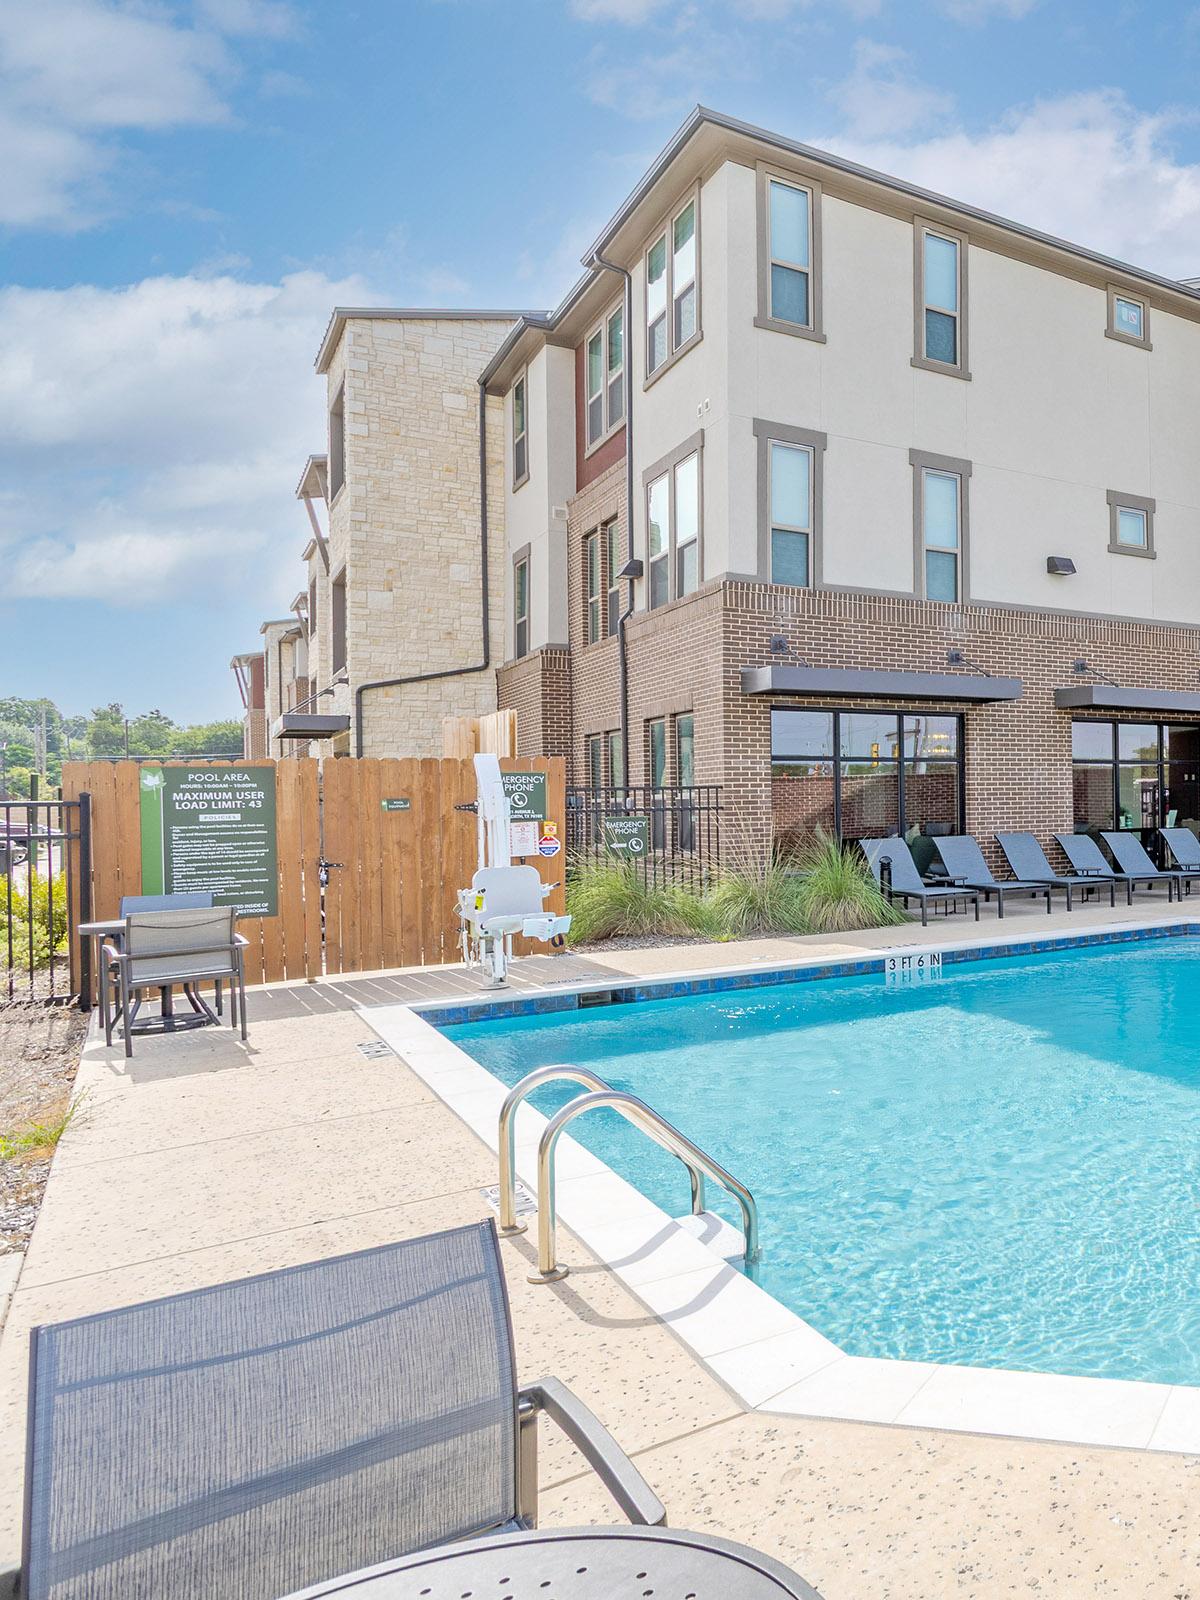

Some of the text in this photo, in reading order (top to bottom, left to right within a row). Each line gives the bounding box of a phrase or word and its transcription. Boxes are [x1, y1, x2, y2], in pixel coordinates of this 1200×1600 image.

[188, 773, 251, 782] POOL AREA
[504, 783, 534, 792] PHONE
[172, 791, 265, 801] MAXIMUM USER
[175, 800, 262, 810] LOAD LIMIT: 43
[606, 820, 646, 828] EMERGENCY
[614, 827, 639, 835] PHONE
[889, 953, 940, 970] 3 FT 6 IN
